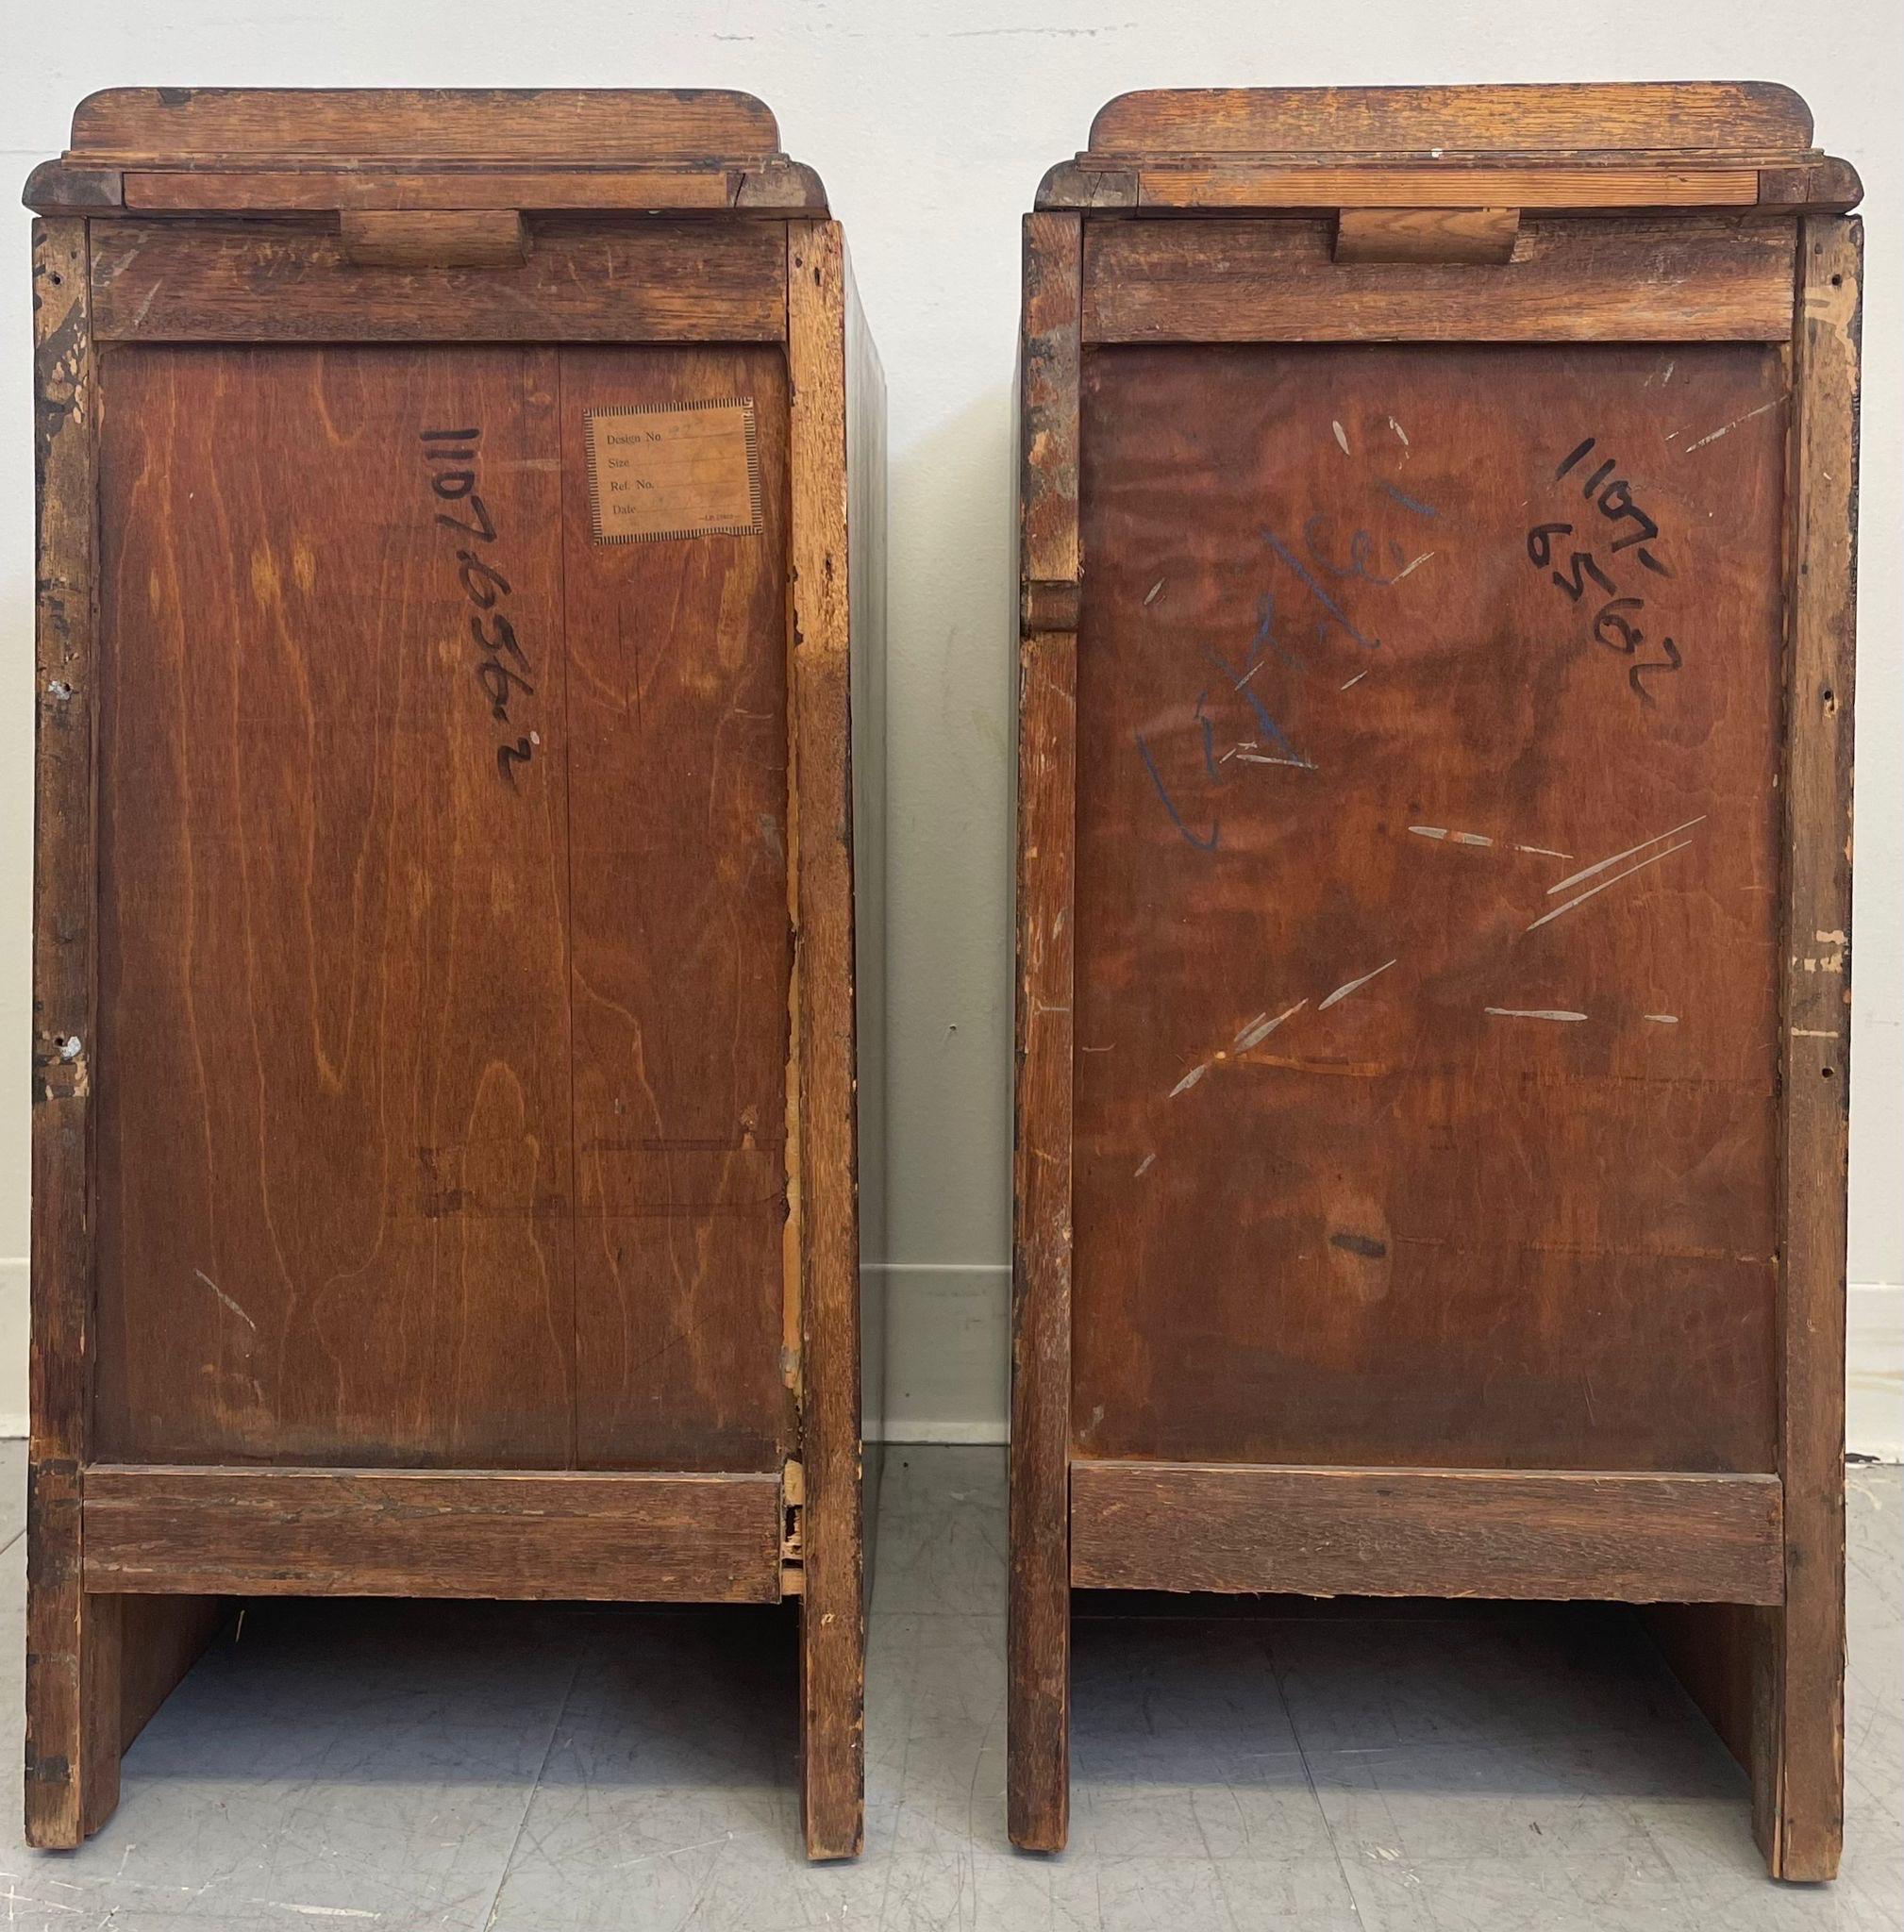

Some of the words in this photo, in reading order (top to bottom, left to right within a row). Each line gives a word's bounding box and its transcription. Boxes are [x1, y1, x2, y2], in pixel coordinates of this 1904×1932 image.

[607, 434, 642, 446] Design
[608, 458, 630, 469] Size
[610, 480, 631, 492] Ref.
[636, 478, 655, 491] No.
[612, 504, 637, 515] Date
